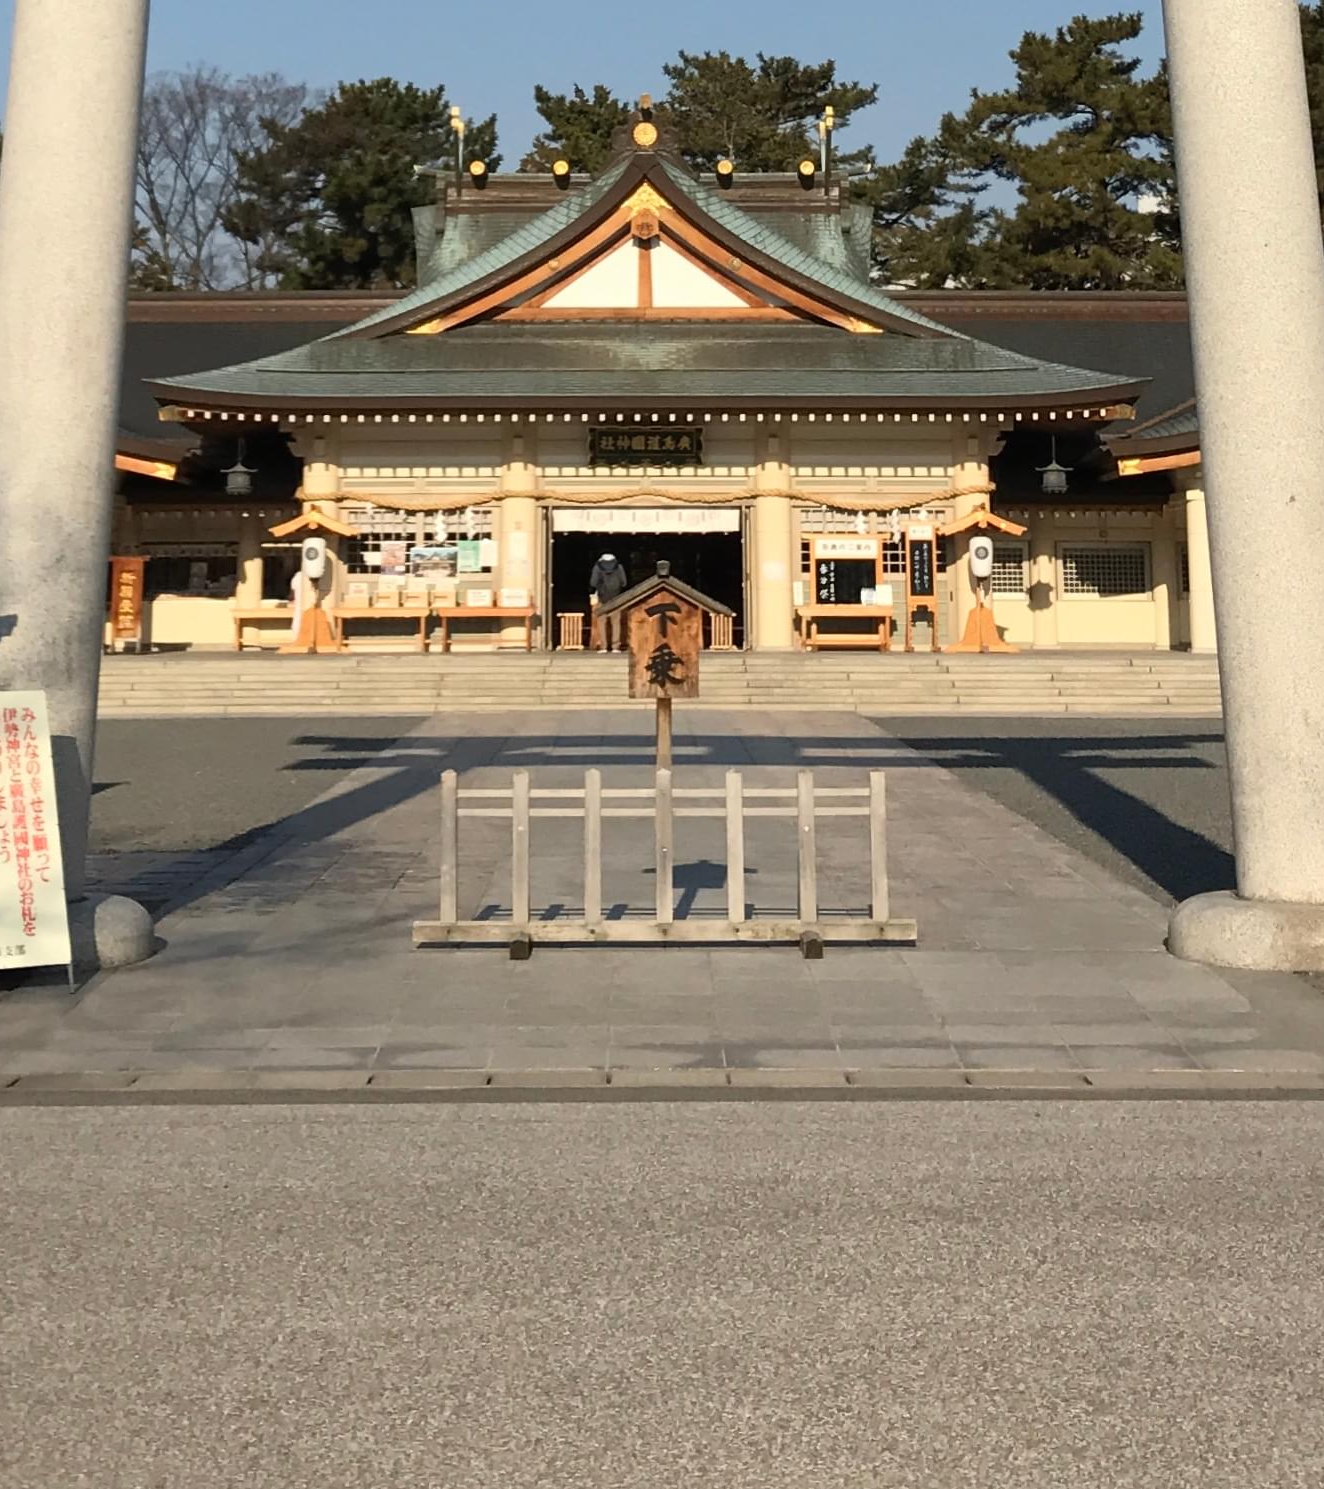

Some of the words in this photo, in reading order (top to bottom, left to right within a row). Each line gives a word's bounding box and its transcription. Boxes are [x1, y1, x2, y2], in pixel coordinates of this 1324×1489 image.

[20, 706, 50, 882] みんなの幸せを願って
